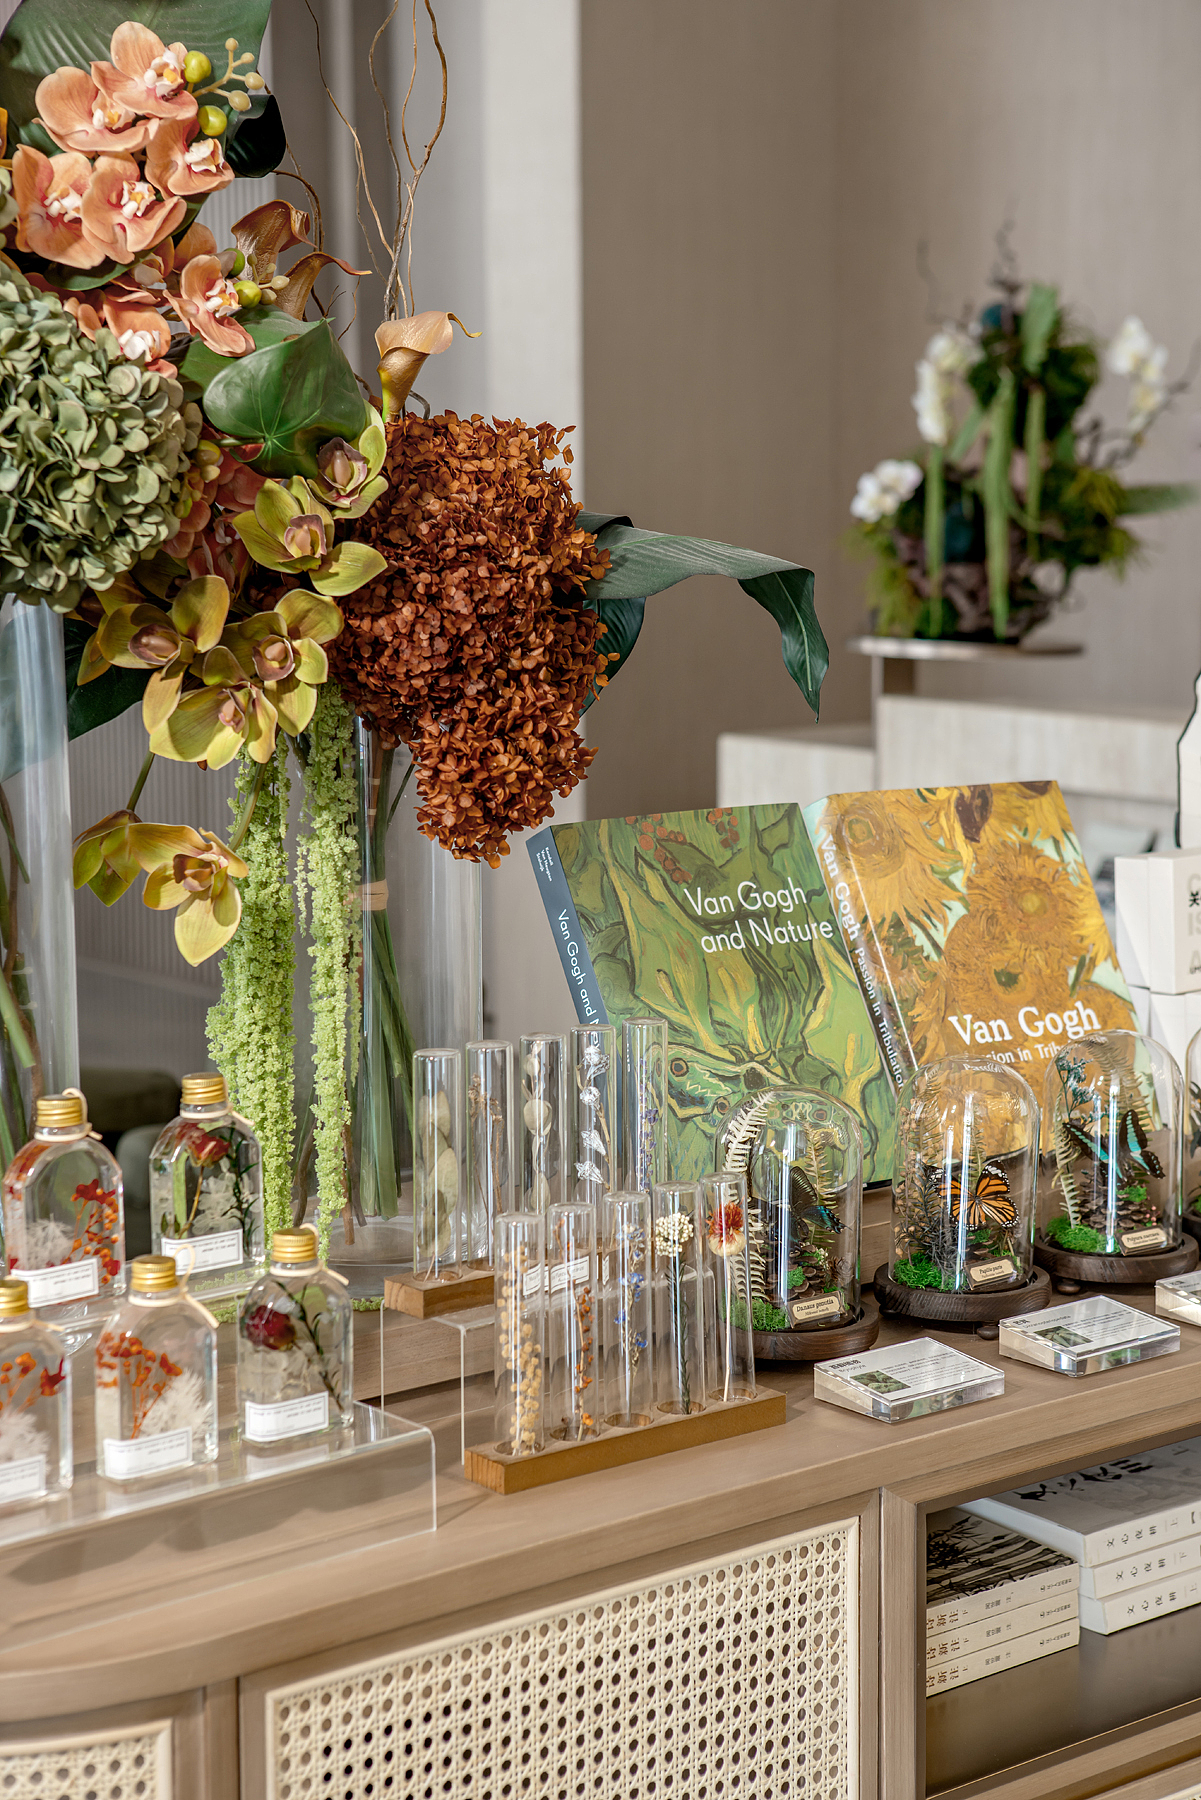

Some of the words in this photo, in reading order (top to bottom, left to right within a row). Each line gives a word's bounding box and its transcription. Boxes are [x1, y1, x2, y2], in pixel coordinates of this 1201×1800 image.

[684, 886, 735, 915] Van
[737, 876, 807, 912] Gogh
[701, 920, 746, 953] and
[748, 917, 834, 946] Nature
[820, 835, 838, 877] Van
[835, 882, 860, 941] Gogh
[855, 947, 876, 1000] Passion
[873, 1002, 882, 1017] in
[558, 908, 571, 941] Van
[567, 941, 586, 985] Gogh
[580, 989, 597, 1019] and
[948, 1013, 1013, 1046] Van
[1018, 1000, 1101, 1040] Gogh
[1017, 1047, 1033, 1061] in
